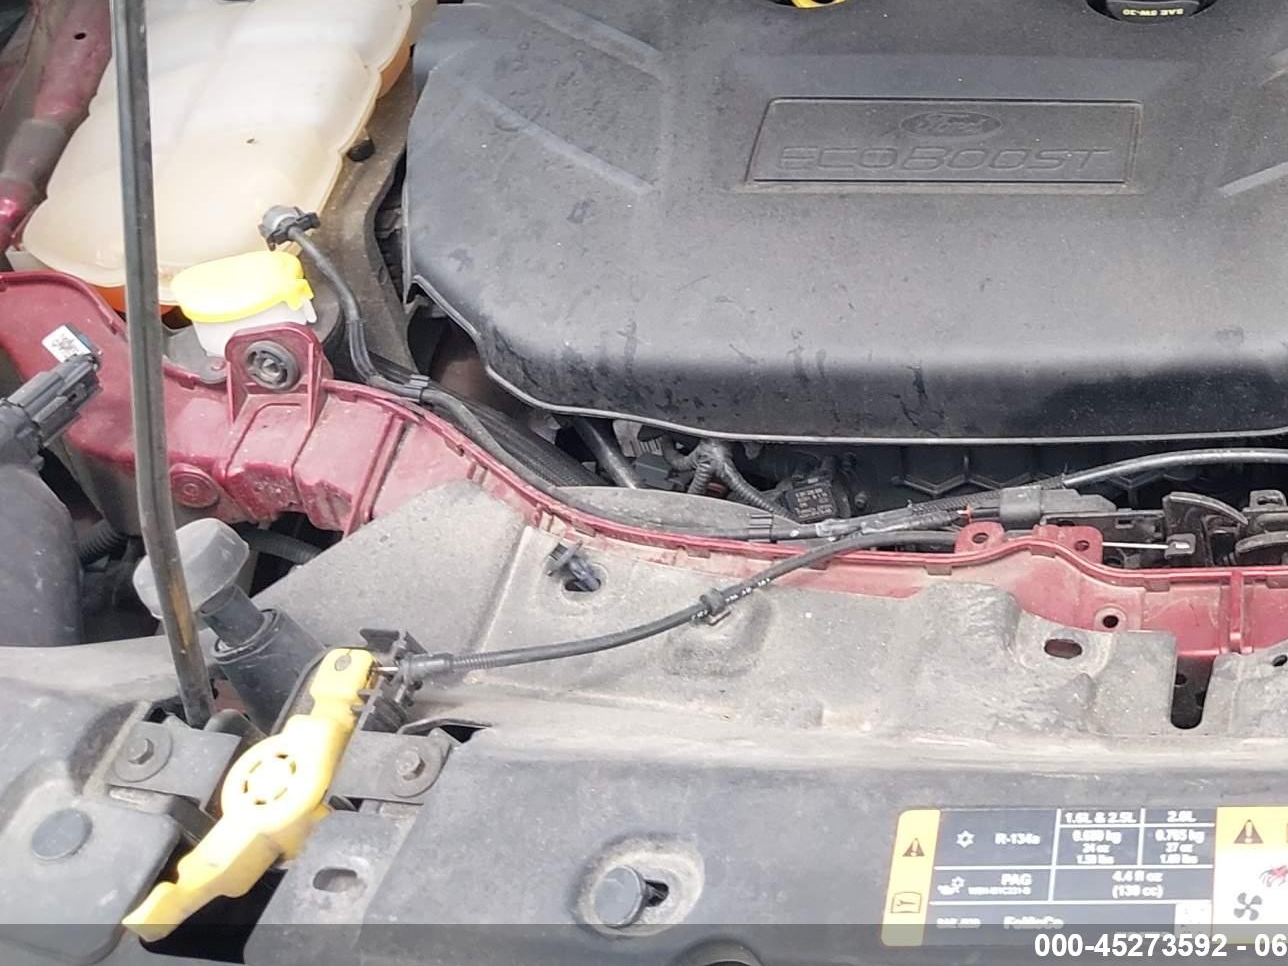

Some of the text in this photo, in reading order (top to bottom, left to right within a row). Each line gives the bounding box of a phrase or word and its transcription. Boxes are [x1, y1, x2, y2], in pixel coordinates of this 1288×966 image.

[1159, 8, 1184, 16] SAE
[994, 832, 1041, 845] R-134a
[1188, 828, 1205, 844] kg
[1001, 872, 1032, 886] PAG
[1146, 872, 1163, 882] oz
